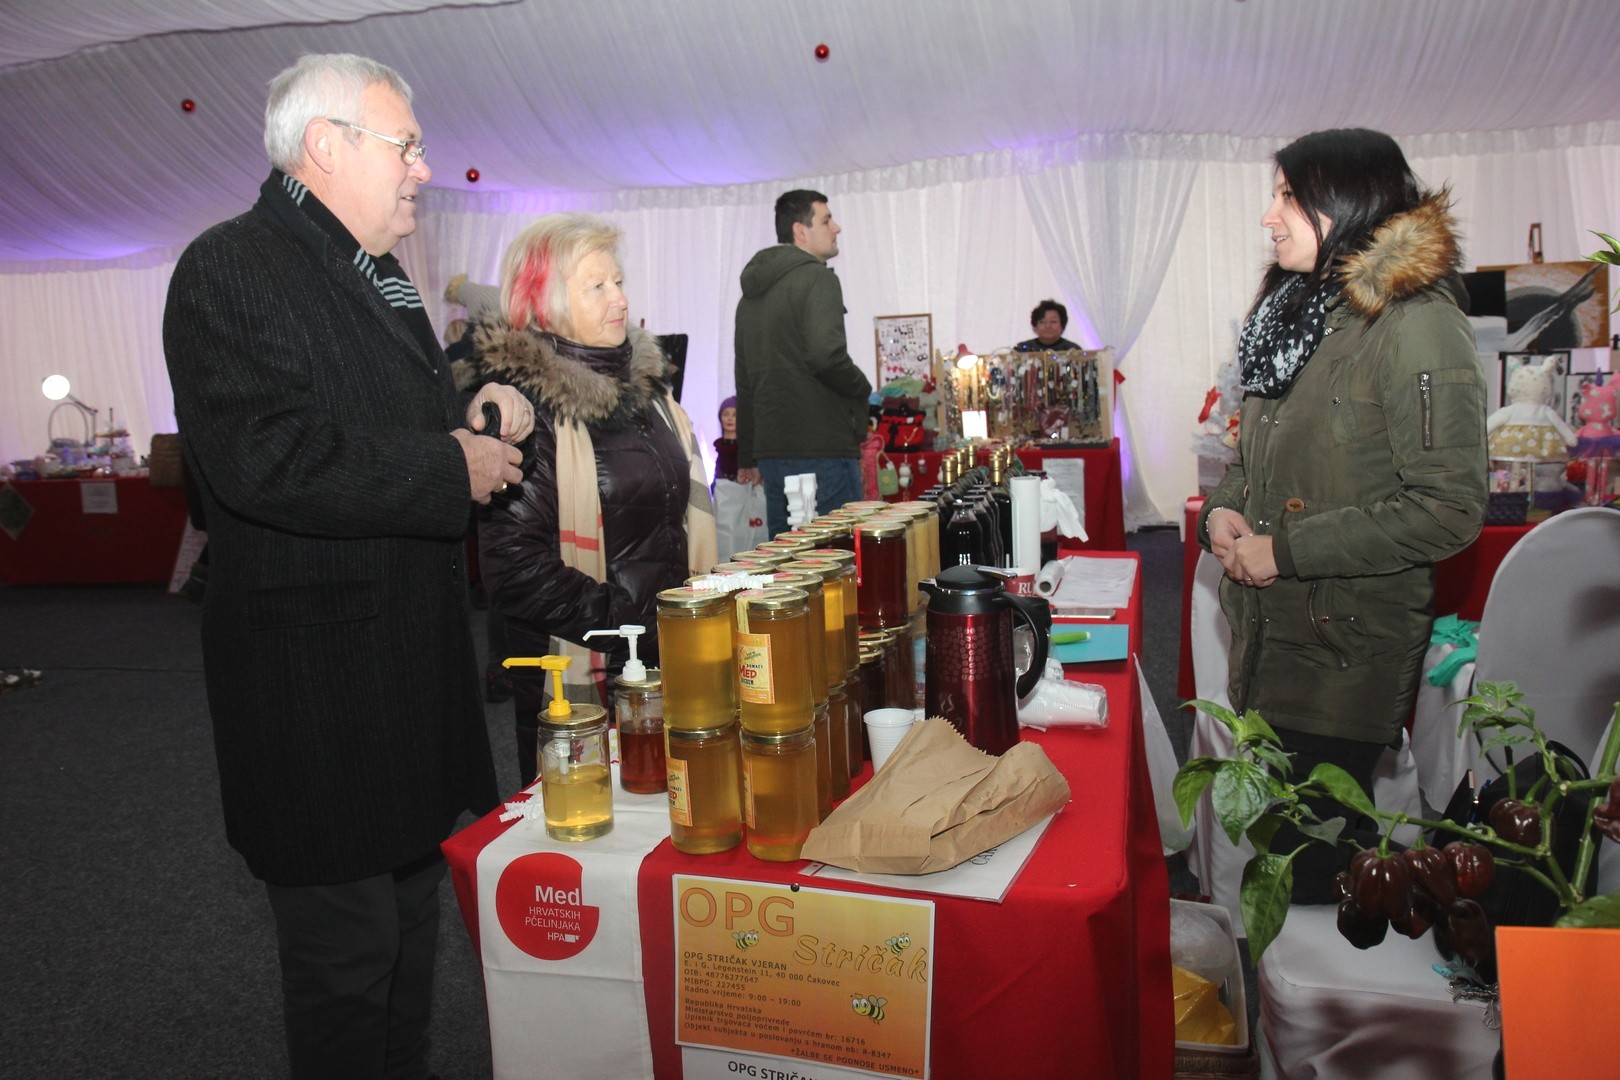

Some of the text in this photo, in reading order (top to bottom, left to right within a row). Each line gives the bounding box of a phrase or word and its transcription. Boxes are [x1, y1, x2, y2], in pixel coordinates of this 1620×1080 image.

[536, 885, 580, 906] Med
[529, 906, 580, 919] HRVATSKIH
[680, 887, 794, 938] OPG
[525, 916, 580, 931] PČELINJAKA
[548, 932, 565, 941] HPA
[684, 952, 787, 970] OPG STRIČAK VJERAN
[792, 934, 927, 984] Stričak
[684, 977, 713, 986] MIBPG:
[713, 964, 756, 974] Legenstein
[760, 970, 772, 978] 11,
[806, 974, 840, 986] Čakovec
[684, 986, 708, 994] Radno
[712, 990, 745, 998] vrijeme:
[749, 993, 767, 1002] 9:00
[778, 998, 801, 1006] 19:00
[685, 998, 762, 1014] Republika Hrvatska
[685, 1006, 790, 1026] Ministarstvo poljoprivrede
[685, 1014, 714, 1022] Upisnik
[684, 1022, 710, 1031] Objekt
[714, 1026, 748, 1036] subjekta
[759, 1032, 802, 1045] poslovanju
[812, 1040, 842, 1052] hranom
[728, 1060, 757, 1077] OPG
[824, 1054, 833, 1062] SE
[836, 1056, 876, 1070] PODNOSE
